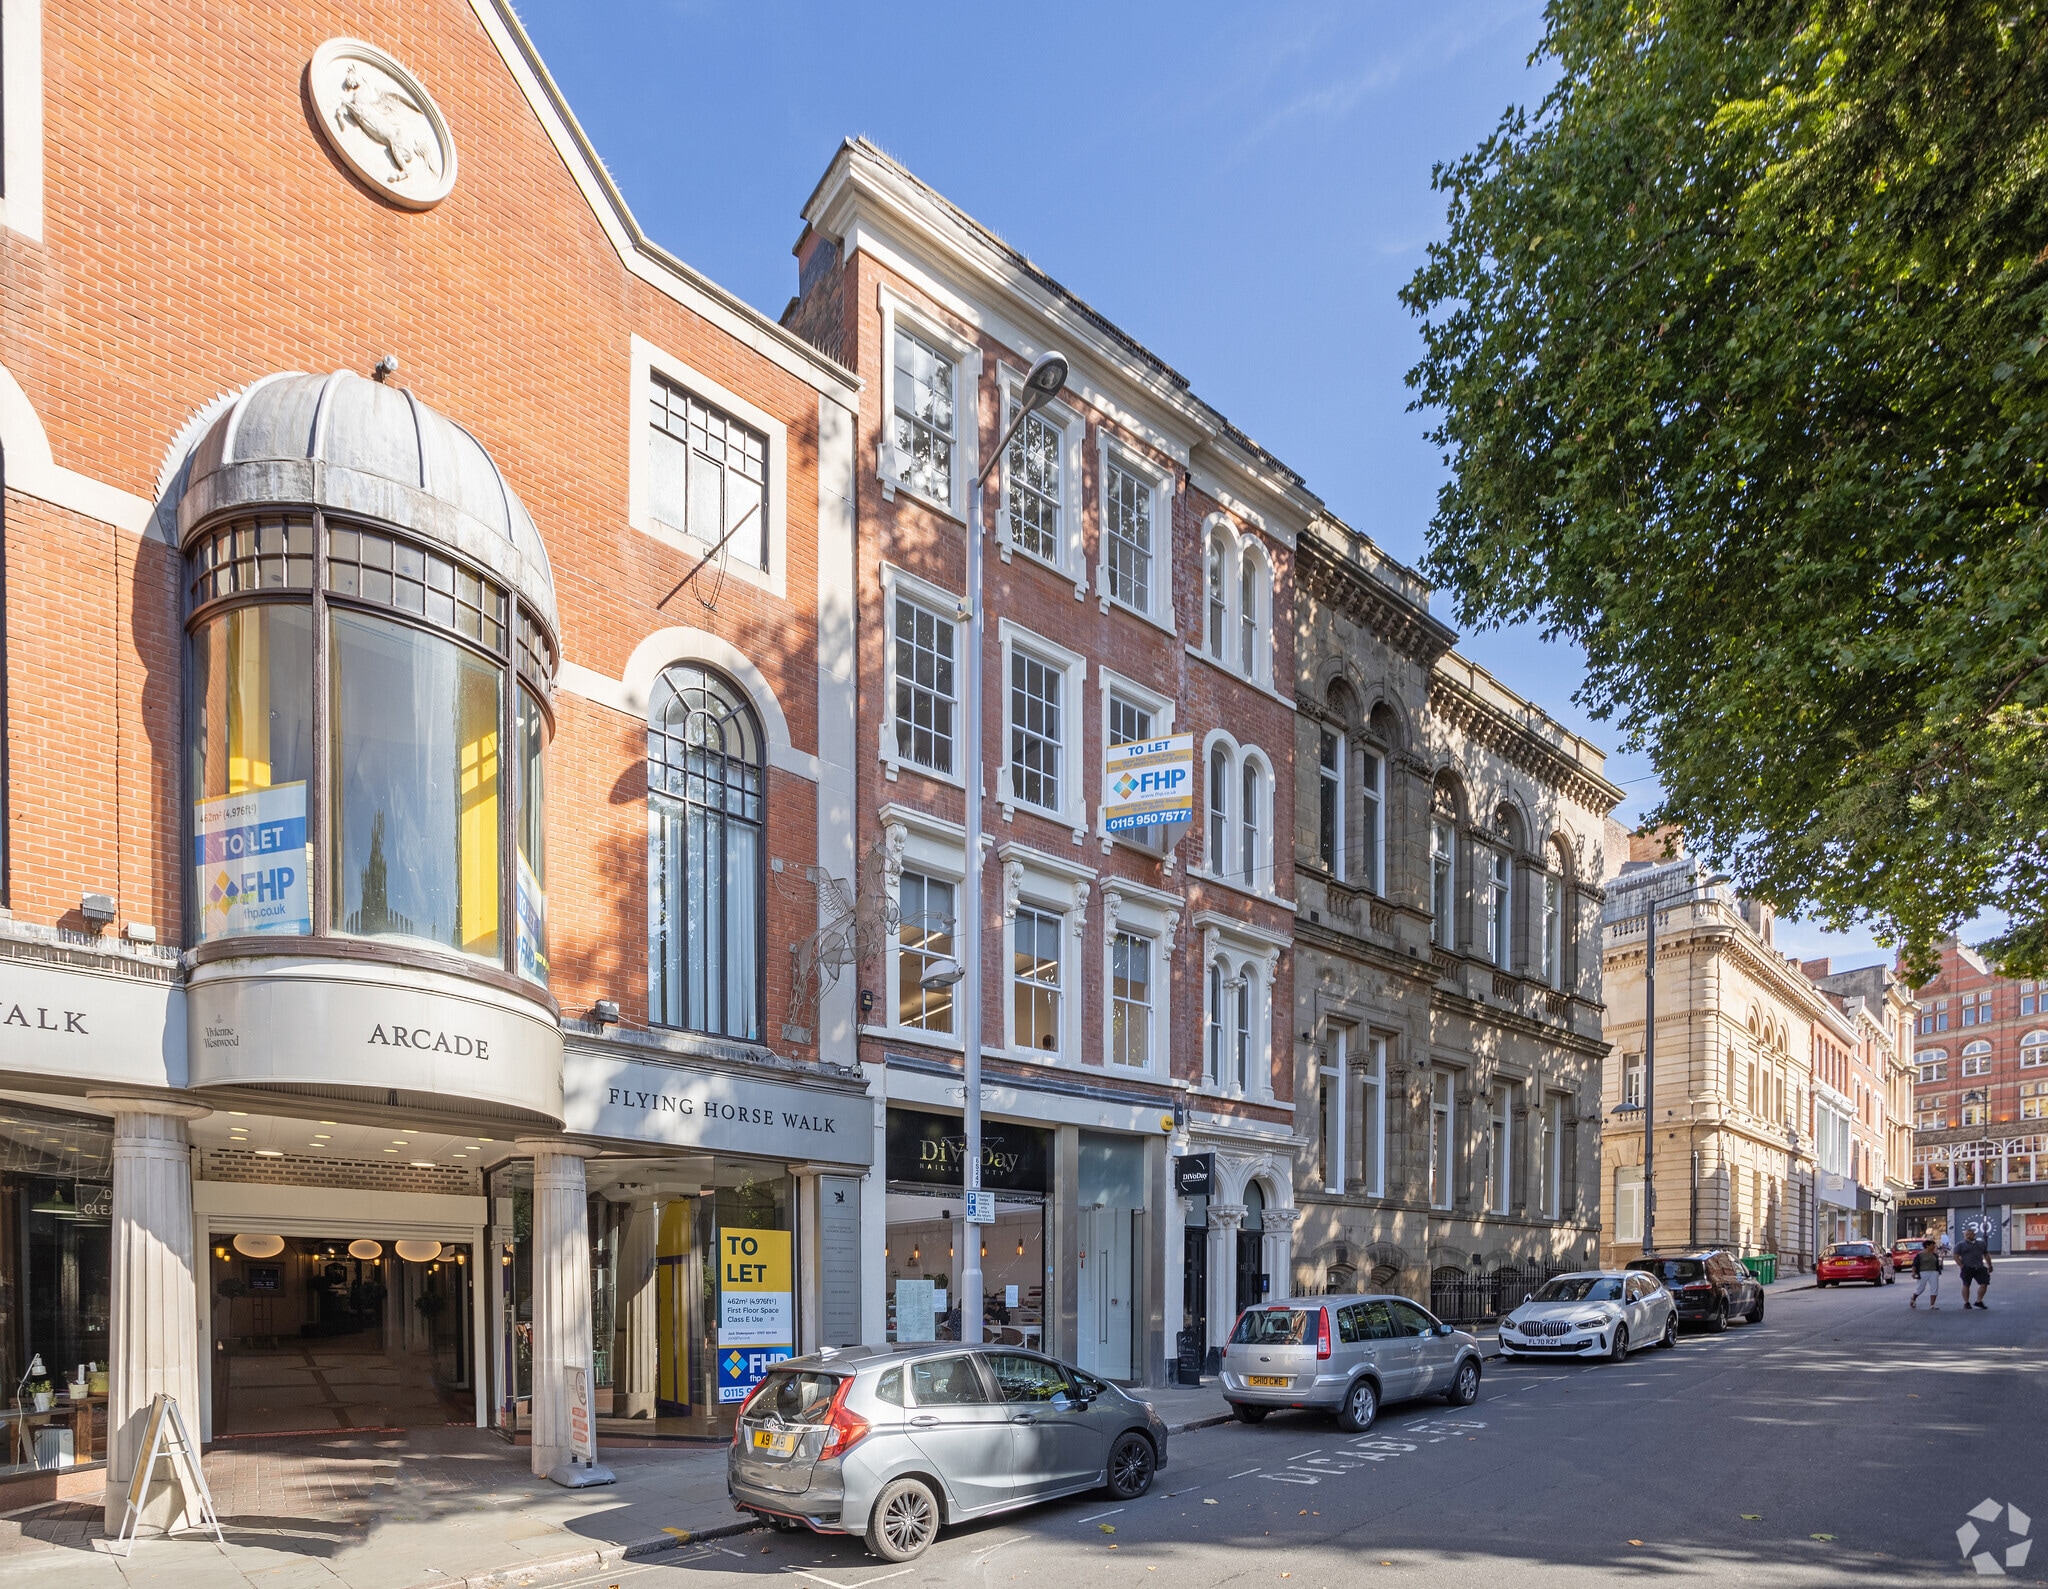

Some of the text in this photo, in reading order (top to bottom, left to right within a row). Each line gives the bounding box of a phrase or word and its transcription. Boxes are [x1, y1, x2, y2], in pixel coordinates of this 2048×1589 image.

[1128, 741, 1170, 756] TO LET
[1141, 769, 1186, 792] FHP
[1110, 810, 1187, 830] 0115 950 7577
[218, 826, 284, 856] TO LET
[241, 866, 295, 905] FHP
[244, 903, 286, 920] fhp.co.uk
[0, 1002, 89, 1034] ALK
[204, 1035, 239, 1048] Westwood
[367, 1024, 490, 1060] ARCADE
[609, 1088, 835, 1133] FLYING HORSE WALK
[727, 1236, 758, 1255] TO
[727, 1264, 767, 1283] LET
[761, 1307, 780, 1315] Space
[1253, 1377, 1268, 1385] SH10
[724, 1388, 744, 1398] 0115
[761, 1433, 770, 1446] A9
